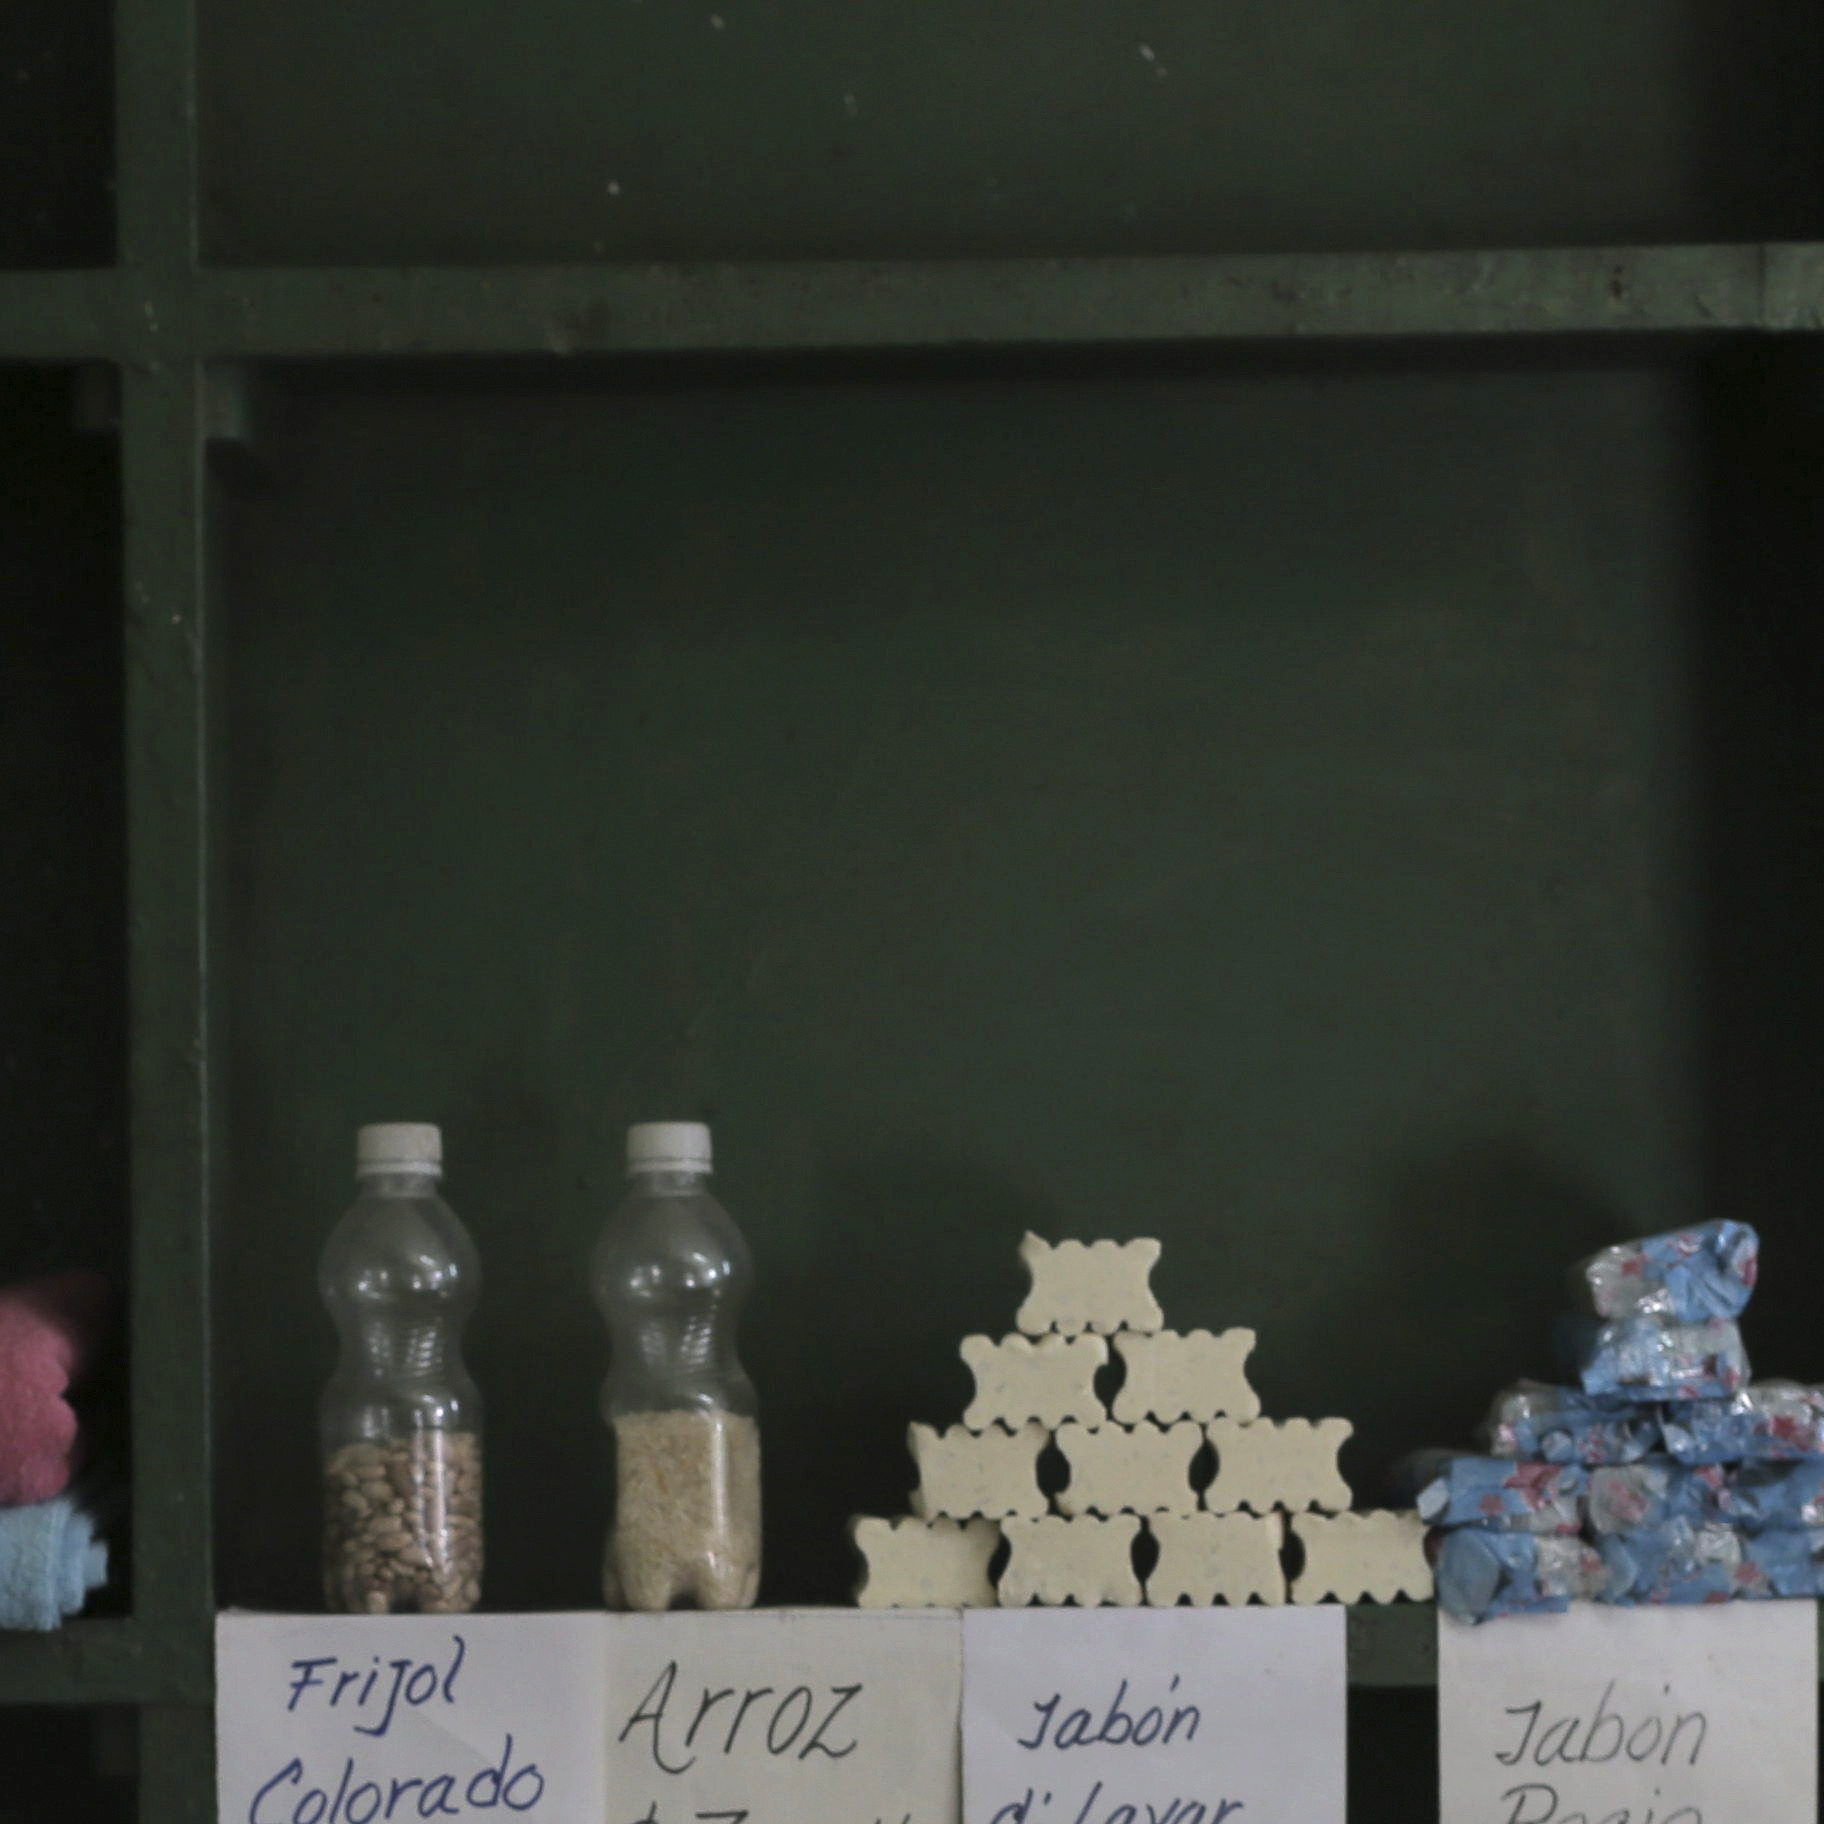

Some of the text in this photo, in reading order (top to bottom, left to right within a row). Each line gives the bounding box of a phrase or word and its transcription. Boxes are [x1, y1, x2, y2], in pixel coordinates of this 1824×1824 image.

[288, 1635, 466, 1737] Frijol
[619, 1660, 864, 1775] Arroz
[1017, 1674, 1202, 1751] Jabón
